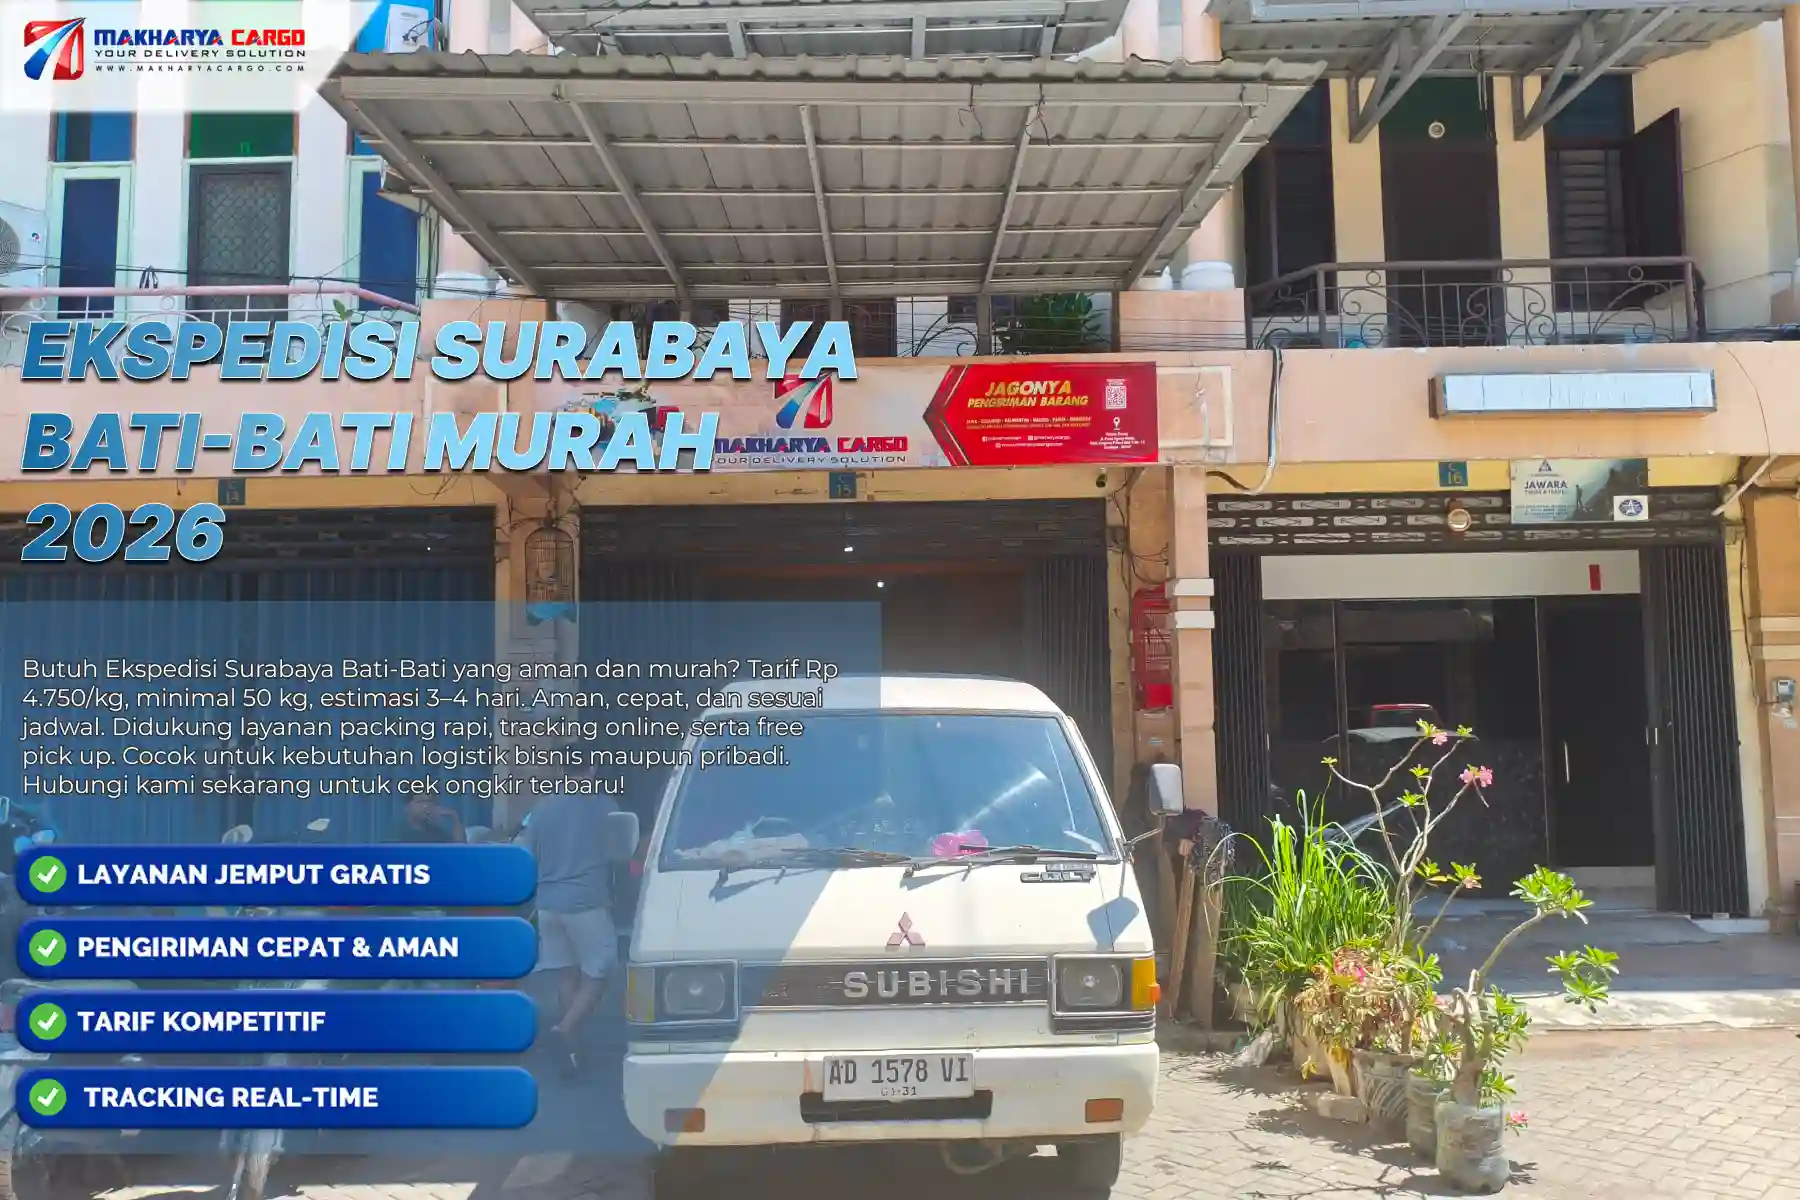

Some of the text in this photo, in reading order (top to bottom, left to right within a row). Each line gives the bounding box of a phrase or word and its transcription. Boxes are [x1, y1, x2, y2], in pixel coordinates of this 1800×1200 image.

[985, 380, 1072, 396] JAGONYA
[1040, 395, 1089, 407] BARANG
[837, 436, 908, 453] CARGO
[711, 455, 907, 464] OUR DELIVERY SOLUTION
[1524, 480, 1568, 489] JAWARA
[843, 968, 1028, 998] SUBISHI
[829, 1057, 969, 1085] AD 1578 VI
